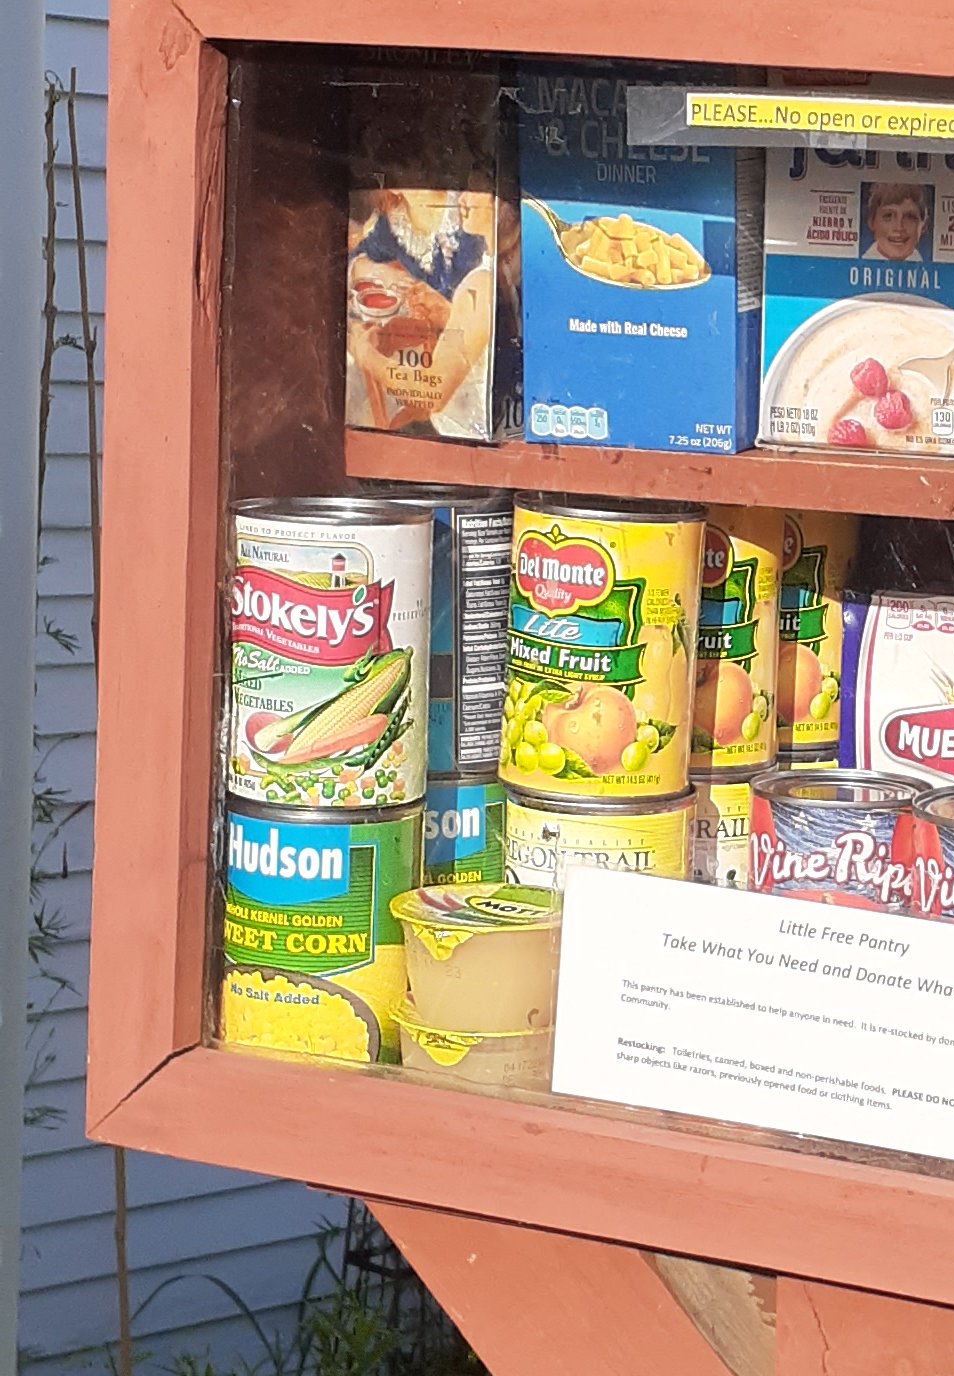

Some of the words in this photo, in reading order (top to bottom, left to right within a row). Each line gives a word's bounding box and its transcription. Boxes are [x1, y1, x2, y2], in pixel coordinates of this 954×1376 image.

[807, 111, 856, 132] open
[862, 114, 881, 129] or
[596, 164, 657, 184] DINNER
[849, 266, 943, 290] ORIGINAL
[569, 318, 598, 333] Made
[600, 321, 621, 335] with
[624, 322, 647, 337] Real
[649, 323, 688, 339] Cheese
[397, 350, 433, 370] 100
[386, 367, 409, 383] Tea
[413, 368, 443, 387] Bags
[934, 411, 951, 423] 130
[668, 435, 689, 447] 7.25
[691, 438, 701, 447] oz
[696, 424, 716, 435] NET
[717, 425, 733, 436] WT
[261, 528, 272, 536] TO
[274, 529, 315, 540] PROTECT
[320, 533, 357, 541] FLAVOR
[520, 552, 541, 581] Del
[541, 558, 606, 589] Monte
[522, 612, 583, 642] Lite
[698, 631, 732, 651] ruit
[510, 637, 552, 665] Mixed
[558, 648, 613, 674] Fruit
[425, 807, 480, 840] son
[695, 817, 749, 840] RAIL
[229, 822, 344, 880] Hudson
[750, 832, 833, 887] Vine
[443, 870, 482, 884] GOLDEN
[250, 909, 288, 927] KERNEL
[291, 914, 343, 928] GOLDEN
[286, 931, 368, 954] CORN
[779, 919, 818, 939] Little
[821, 927, 855, 946] Free
[859, 932, 911, 958] Pantry
[663, 933, 698, 952] Take
[702, 939, 744, 961] What
[747, 947, 775, 966] You
[779, 954, 820, 974] Need
[823, 963, 852, 980] and
[856, 967, 913, 991] Donate
[246, 987, 269, 1003] Salt
[274, 991, 320, 1005] Added
[621, 993, 671, 1012] Community.
[622, 978, 639, 991] This
[641, 983, 667, 998] pantry
[669, 987, 684, 998] has
[686, 990, 708, 1003] been
[709, 994, 756, 1012] established
[758, 1004, 767, 1013] to
[769, 1005, 787, 1019] help
[789, 1010, 821, 1023] anyone
[823, 1014, 831, 1024] in
[833, 1018, 857, 1030] need.
[861, 1021, 868, 1031] It
[870, 1022, 877, 1033] is
[879, 1025, 924, 1042] re-stocked
[926, 1032, 938, 1046] by
[617, 1051, 640, 1065] sharp
[641, 1055, 671, 1071] objects
[673, 1060, 688, 1072] like
[690, 1066, 718, 1081] razors,
[719, 1070, 762, 1089] previously
[763, 1077, 797, 1093] opened
[798, 1082, 818, 1097] food
[819, 1088, 829, 1098] or
[831, 1090, 867, 1108] clothing
[868, 1097, 894, 1111] items.
[778, 1066, 794, 1079] and
[796, 1070, 859, 1091] non-perishable
[861, 1080, 888, 1096] foods.
[892, 1087, 924, 1103] PLEASE
[926, 1094, 940, 1106] DO
